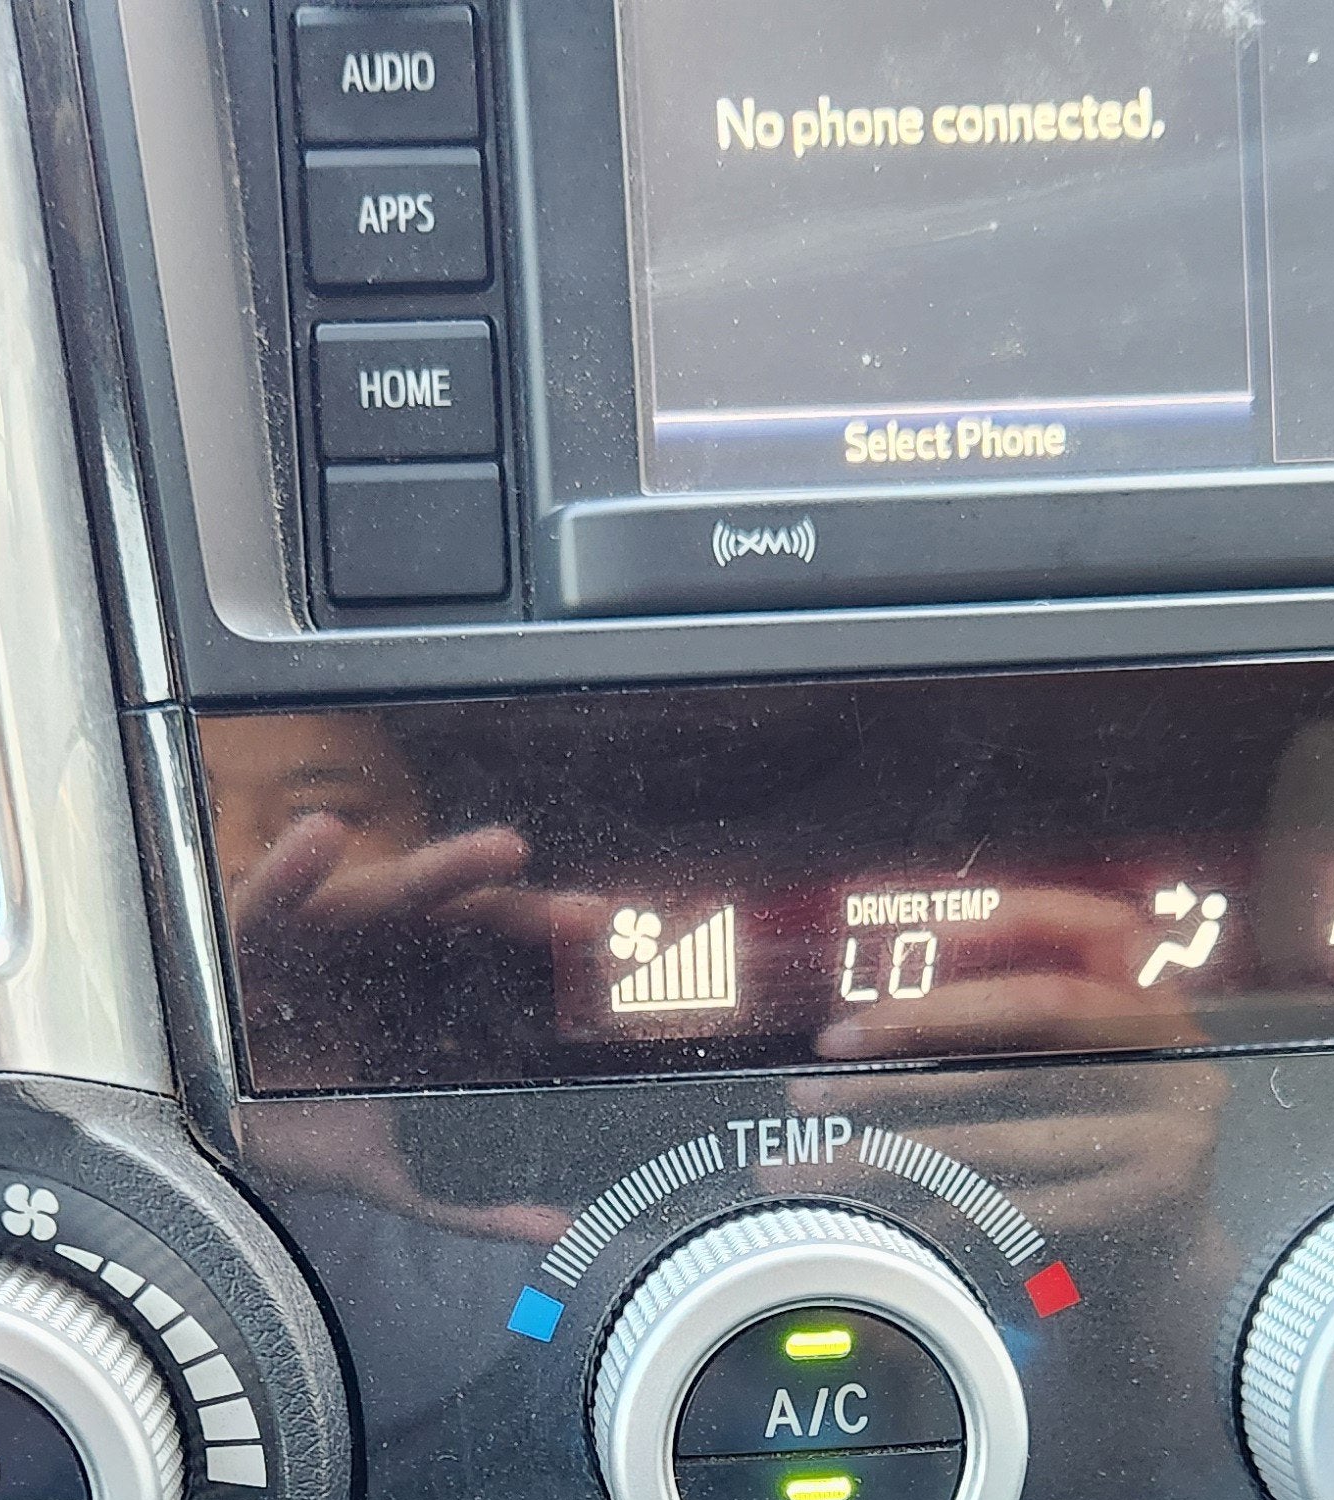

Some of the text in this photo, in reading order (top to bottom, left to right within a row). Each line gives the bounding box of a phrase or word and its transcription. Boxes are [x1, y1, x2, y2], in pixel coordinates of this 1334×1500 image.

[341, 52, 436, 93] AUDIO
[716, 86, 1167, 159] No phone connected.
[358, 194, 436, 234] APPS
[359, 368, 452, 408] HOME
[844, 418, 1067, 464] Select Phone
[847, 890, 1000, 926] DRIVER TEMP
[727, 1116, 854, 1167] TEMP
[764, 1383, 869, 1438] A/C
